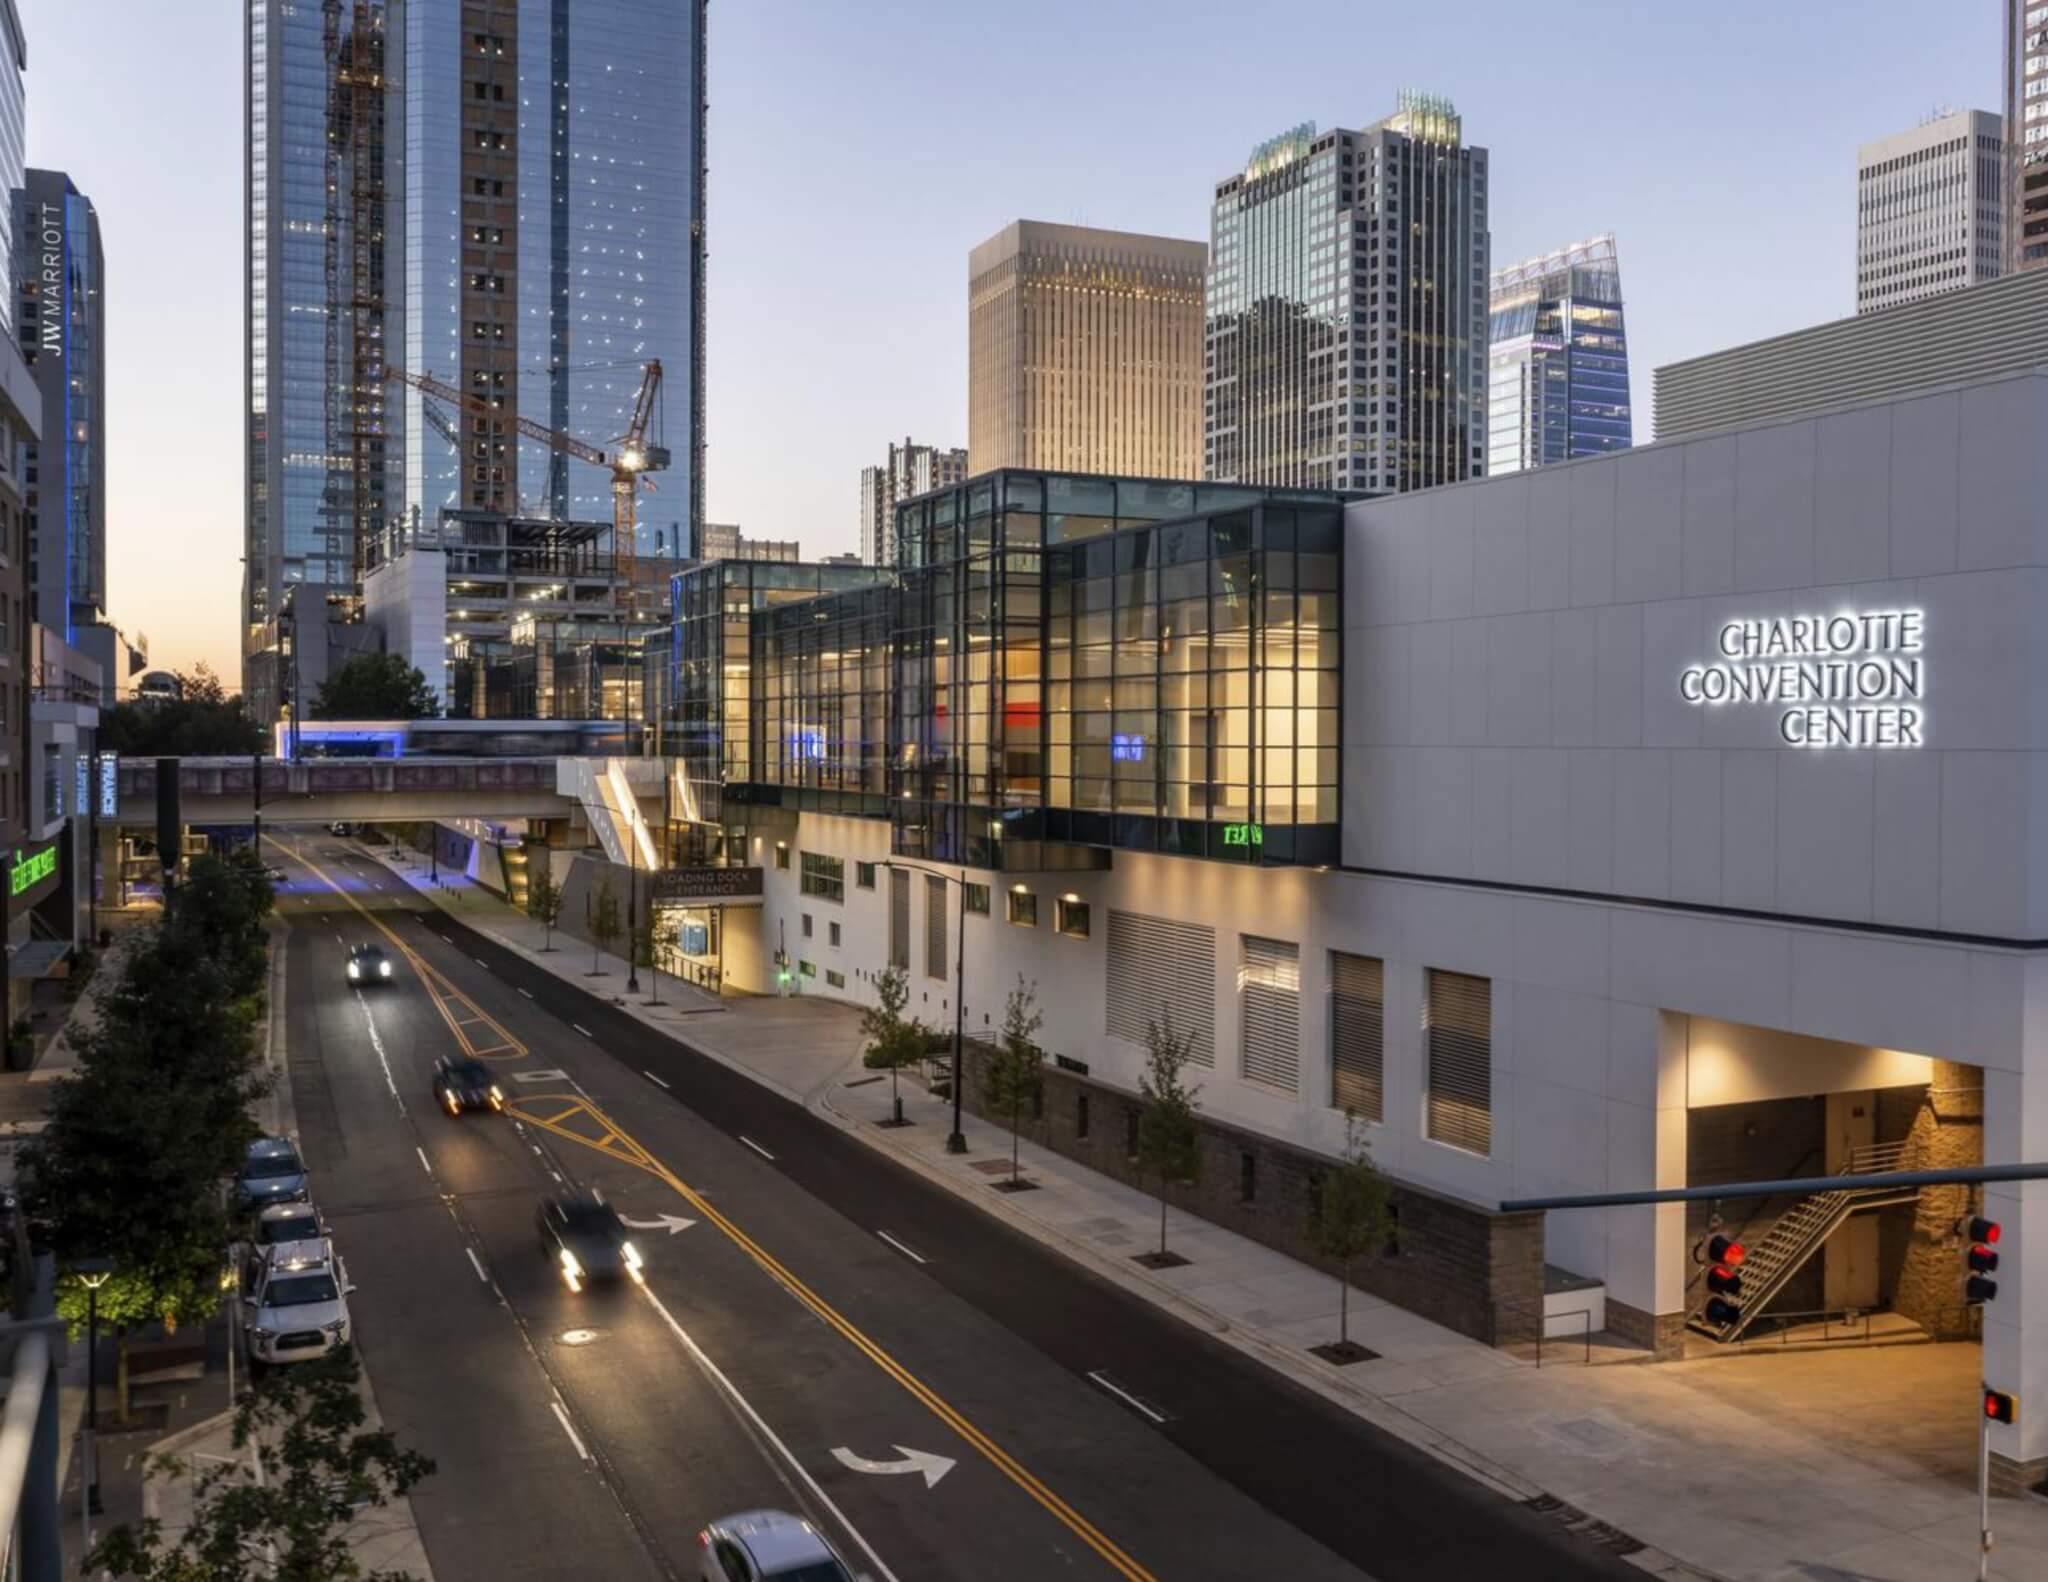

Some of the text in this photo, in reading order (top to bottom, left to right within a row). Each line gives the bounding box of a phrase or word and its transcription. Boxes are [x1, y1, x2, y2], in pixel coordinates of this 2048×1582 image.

[42, 202, 62, 356] JW MARRIOTT
[1719, 612, 1920, 656] CHARLOTTE
[1680, 660, 1920, 701] CONVENTION
[1781, 708, 1919, 744] CENTER
[662, 871, 750, 884] LOADING DOCK
[676, 883, 736, 895] ENTRANCE
